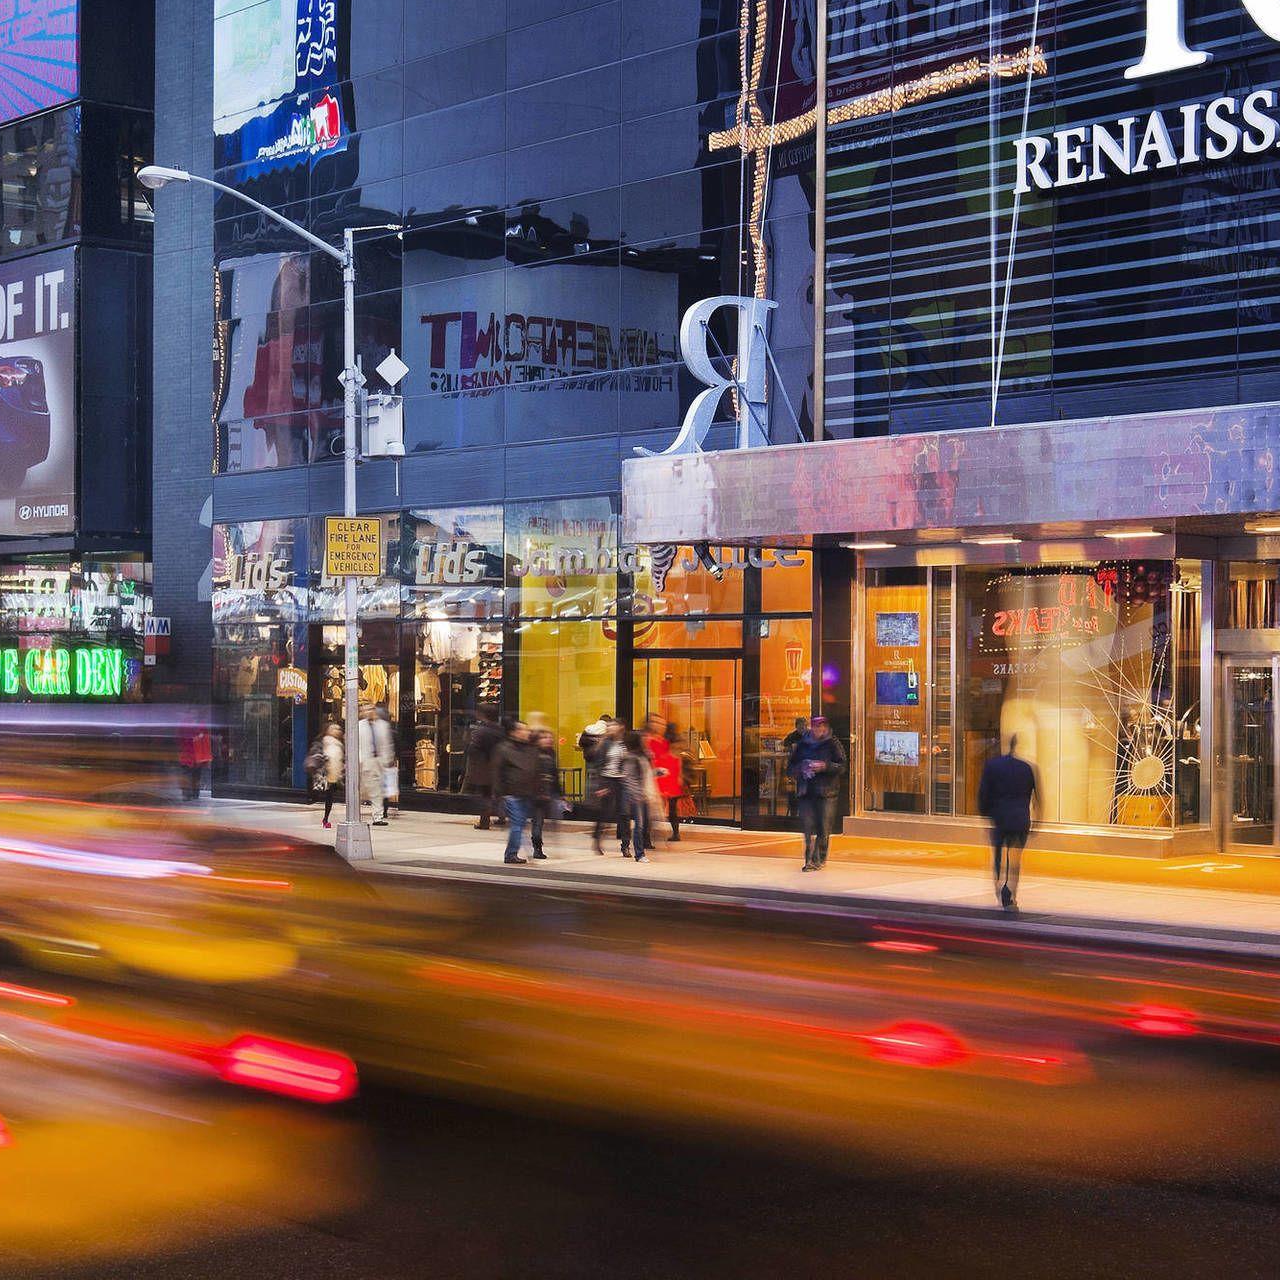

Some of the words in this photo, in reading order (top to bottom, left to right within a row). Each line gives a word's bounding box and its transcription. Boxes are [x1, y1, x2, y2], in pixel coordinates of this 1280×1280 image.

[34, 269, 69, 333] IT.
[32, 503, 70, 518] HYUNDAI
[337, 522, 370, 532] CLEAR
[329, 533, 348, 543] FIRE
[352, 533, 378, 543] LANE
[346, 543, 361, 551] FOR
[329, 551, 378, 562] EMERGENCY
[414, 541, 487, 585] Lids
[512, 539, 644, 578] Jamba
[230, 551, 290, 590] Lids
[333, 562, 375, 572] VEHICLES
[24, 648, 123, 697] GARDEN
